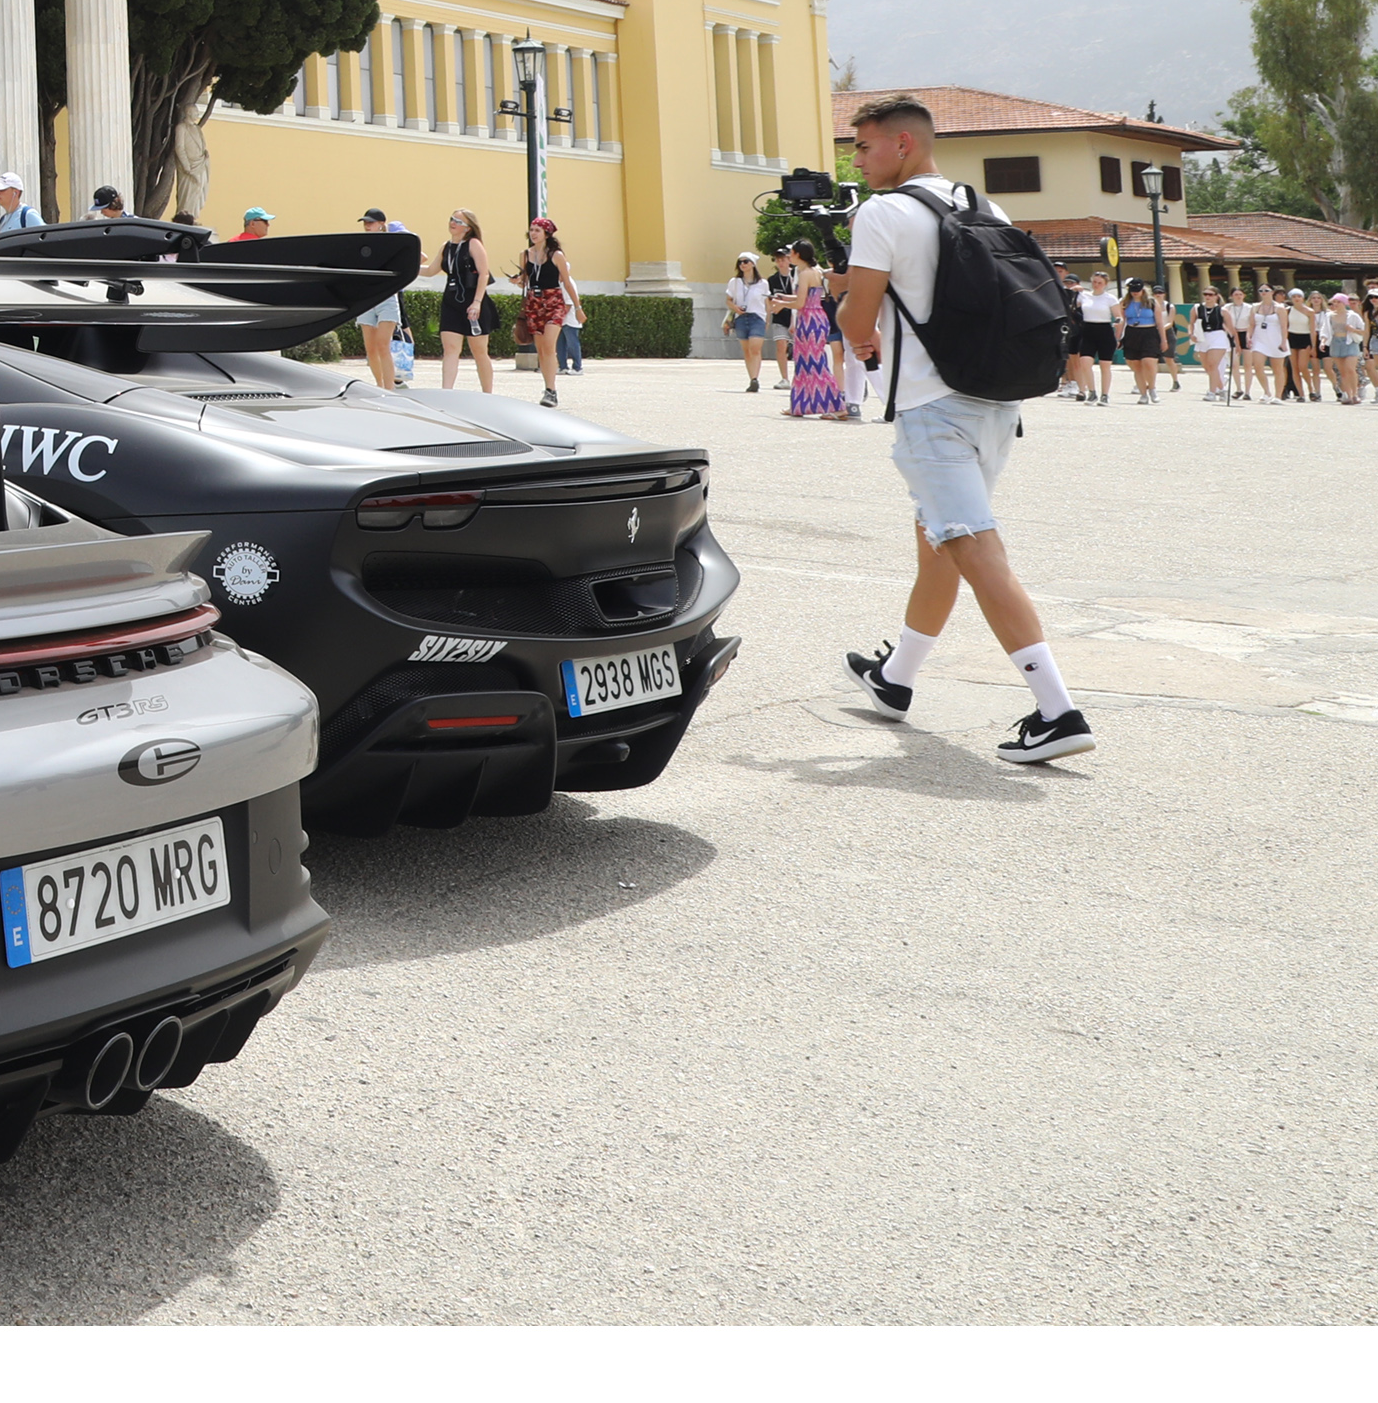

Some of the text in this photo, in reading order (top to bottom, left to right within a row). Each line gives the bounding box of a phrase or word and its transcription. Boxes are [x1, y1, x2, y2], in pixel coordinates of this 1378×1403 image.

[0, 424, 119, 483] IWC
[216, 541, 278, 568] PERFORMANCE
[227, 554, 267, 574] AUTO TALLER
[230, 575, 262, 586] Dani
[241, 565, 253, 578] by
[227, 595, 263, 606] CENTER
[407, 635, 508, 663] SIX2SIX
[580, 650, 675, 706] 2938 MGS
[570, 694, 577, 706] E
[37, 833, 218, 942] 8720 MRG
[12, 926, 24, 947] E
